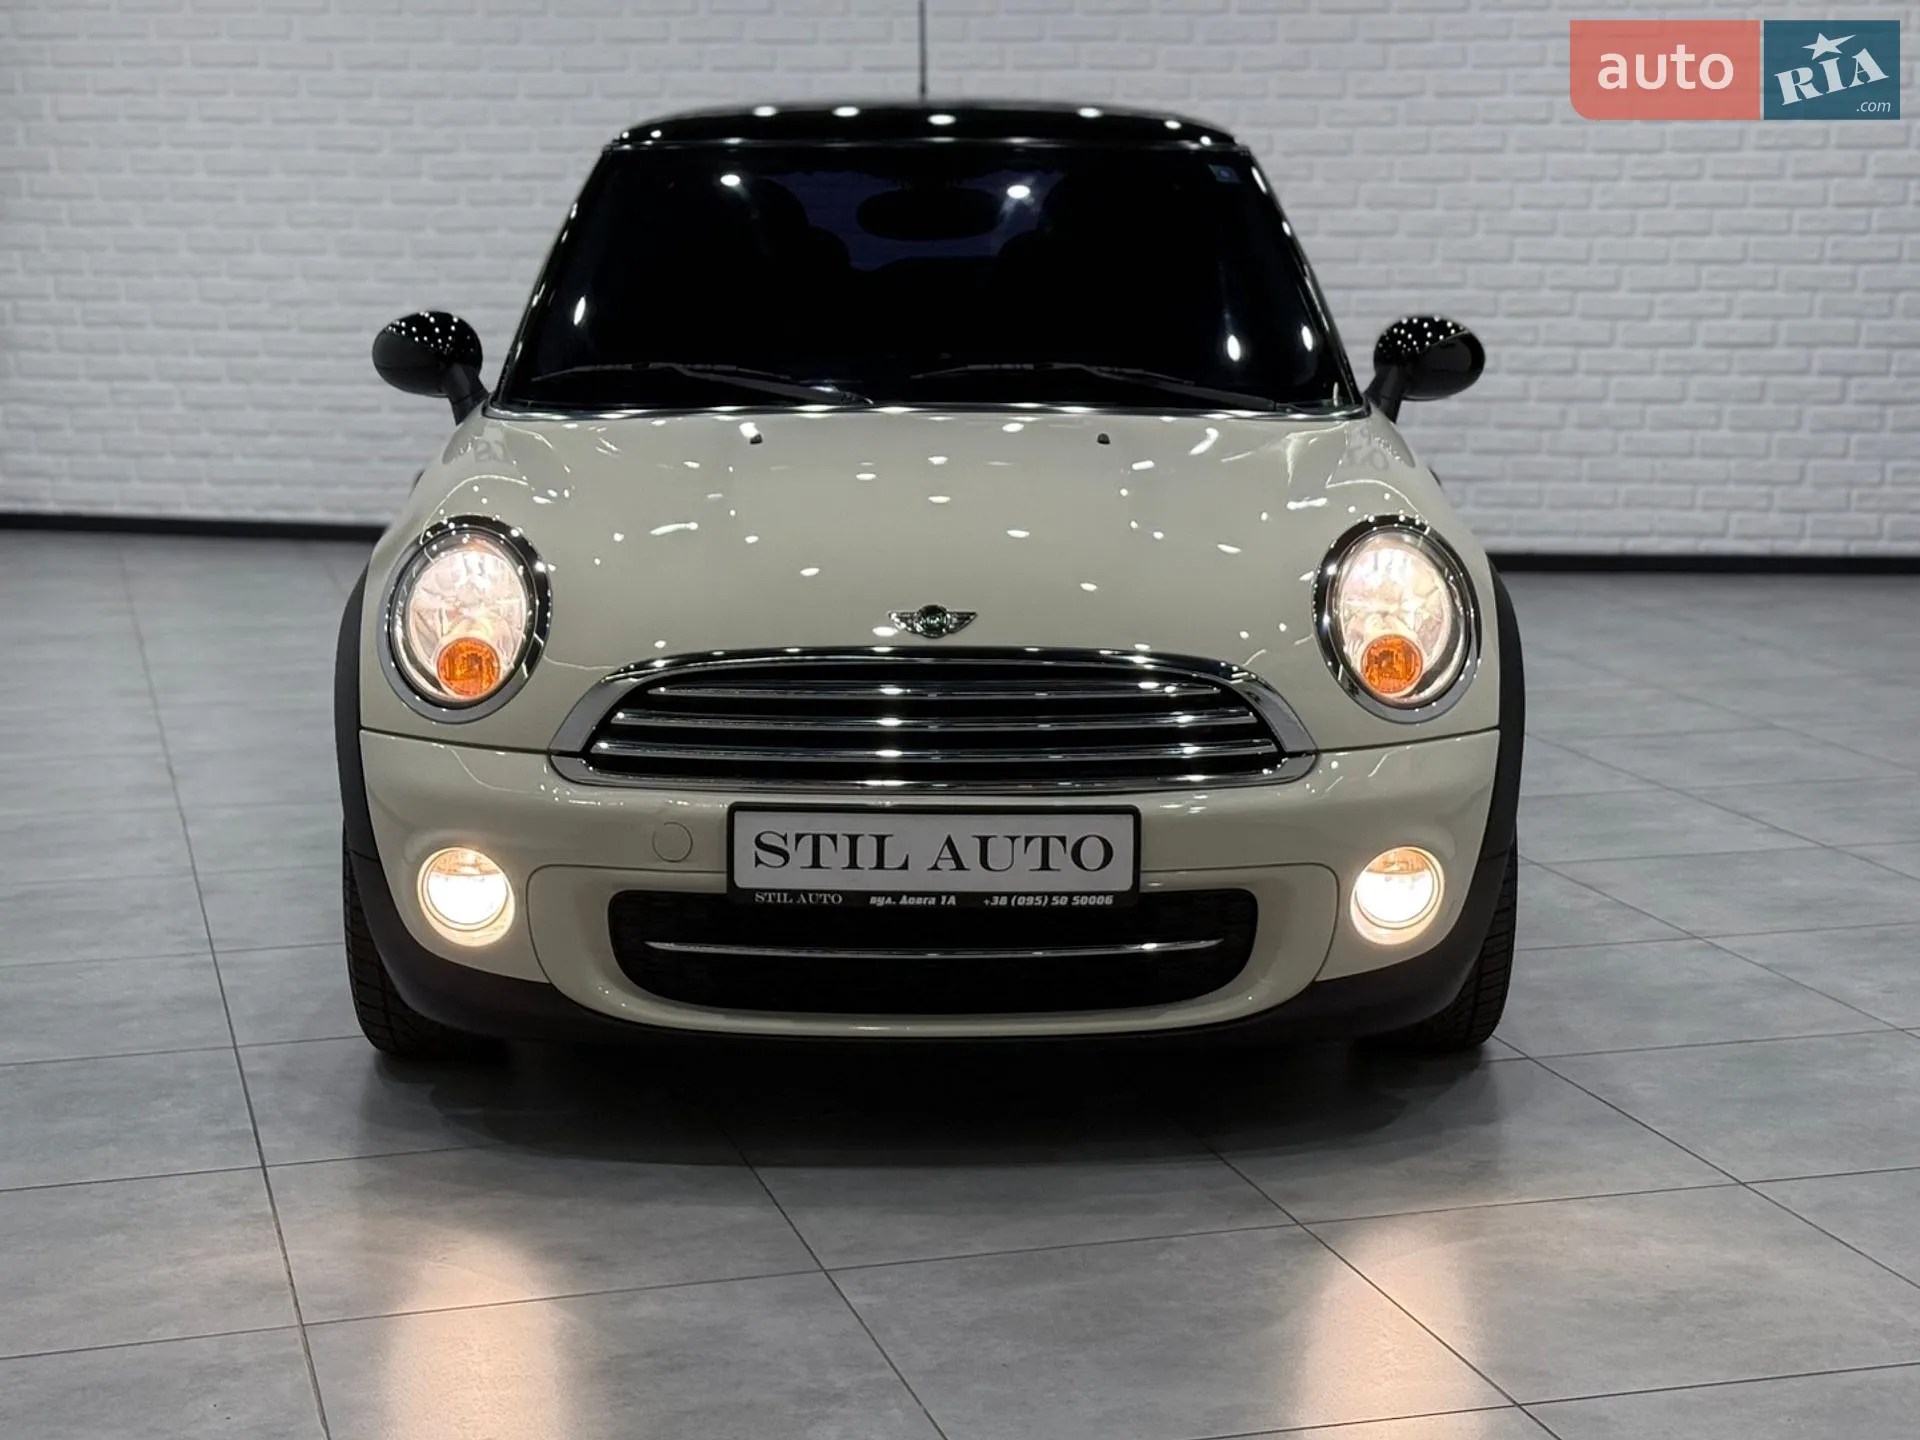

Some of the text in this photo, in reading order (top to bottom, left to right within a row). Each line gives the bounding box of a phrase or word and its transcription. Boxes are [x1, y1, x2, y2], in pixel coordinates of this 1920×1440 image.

[754, 830, 1114, 873] STIL AUTO
[754, 892, 843, 905] STIL AUTO
[983, 895, 1008, 906] +38
[1050, 895, 1068, 906] 50
